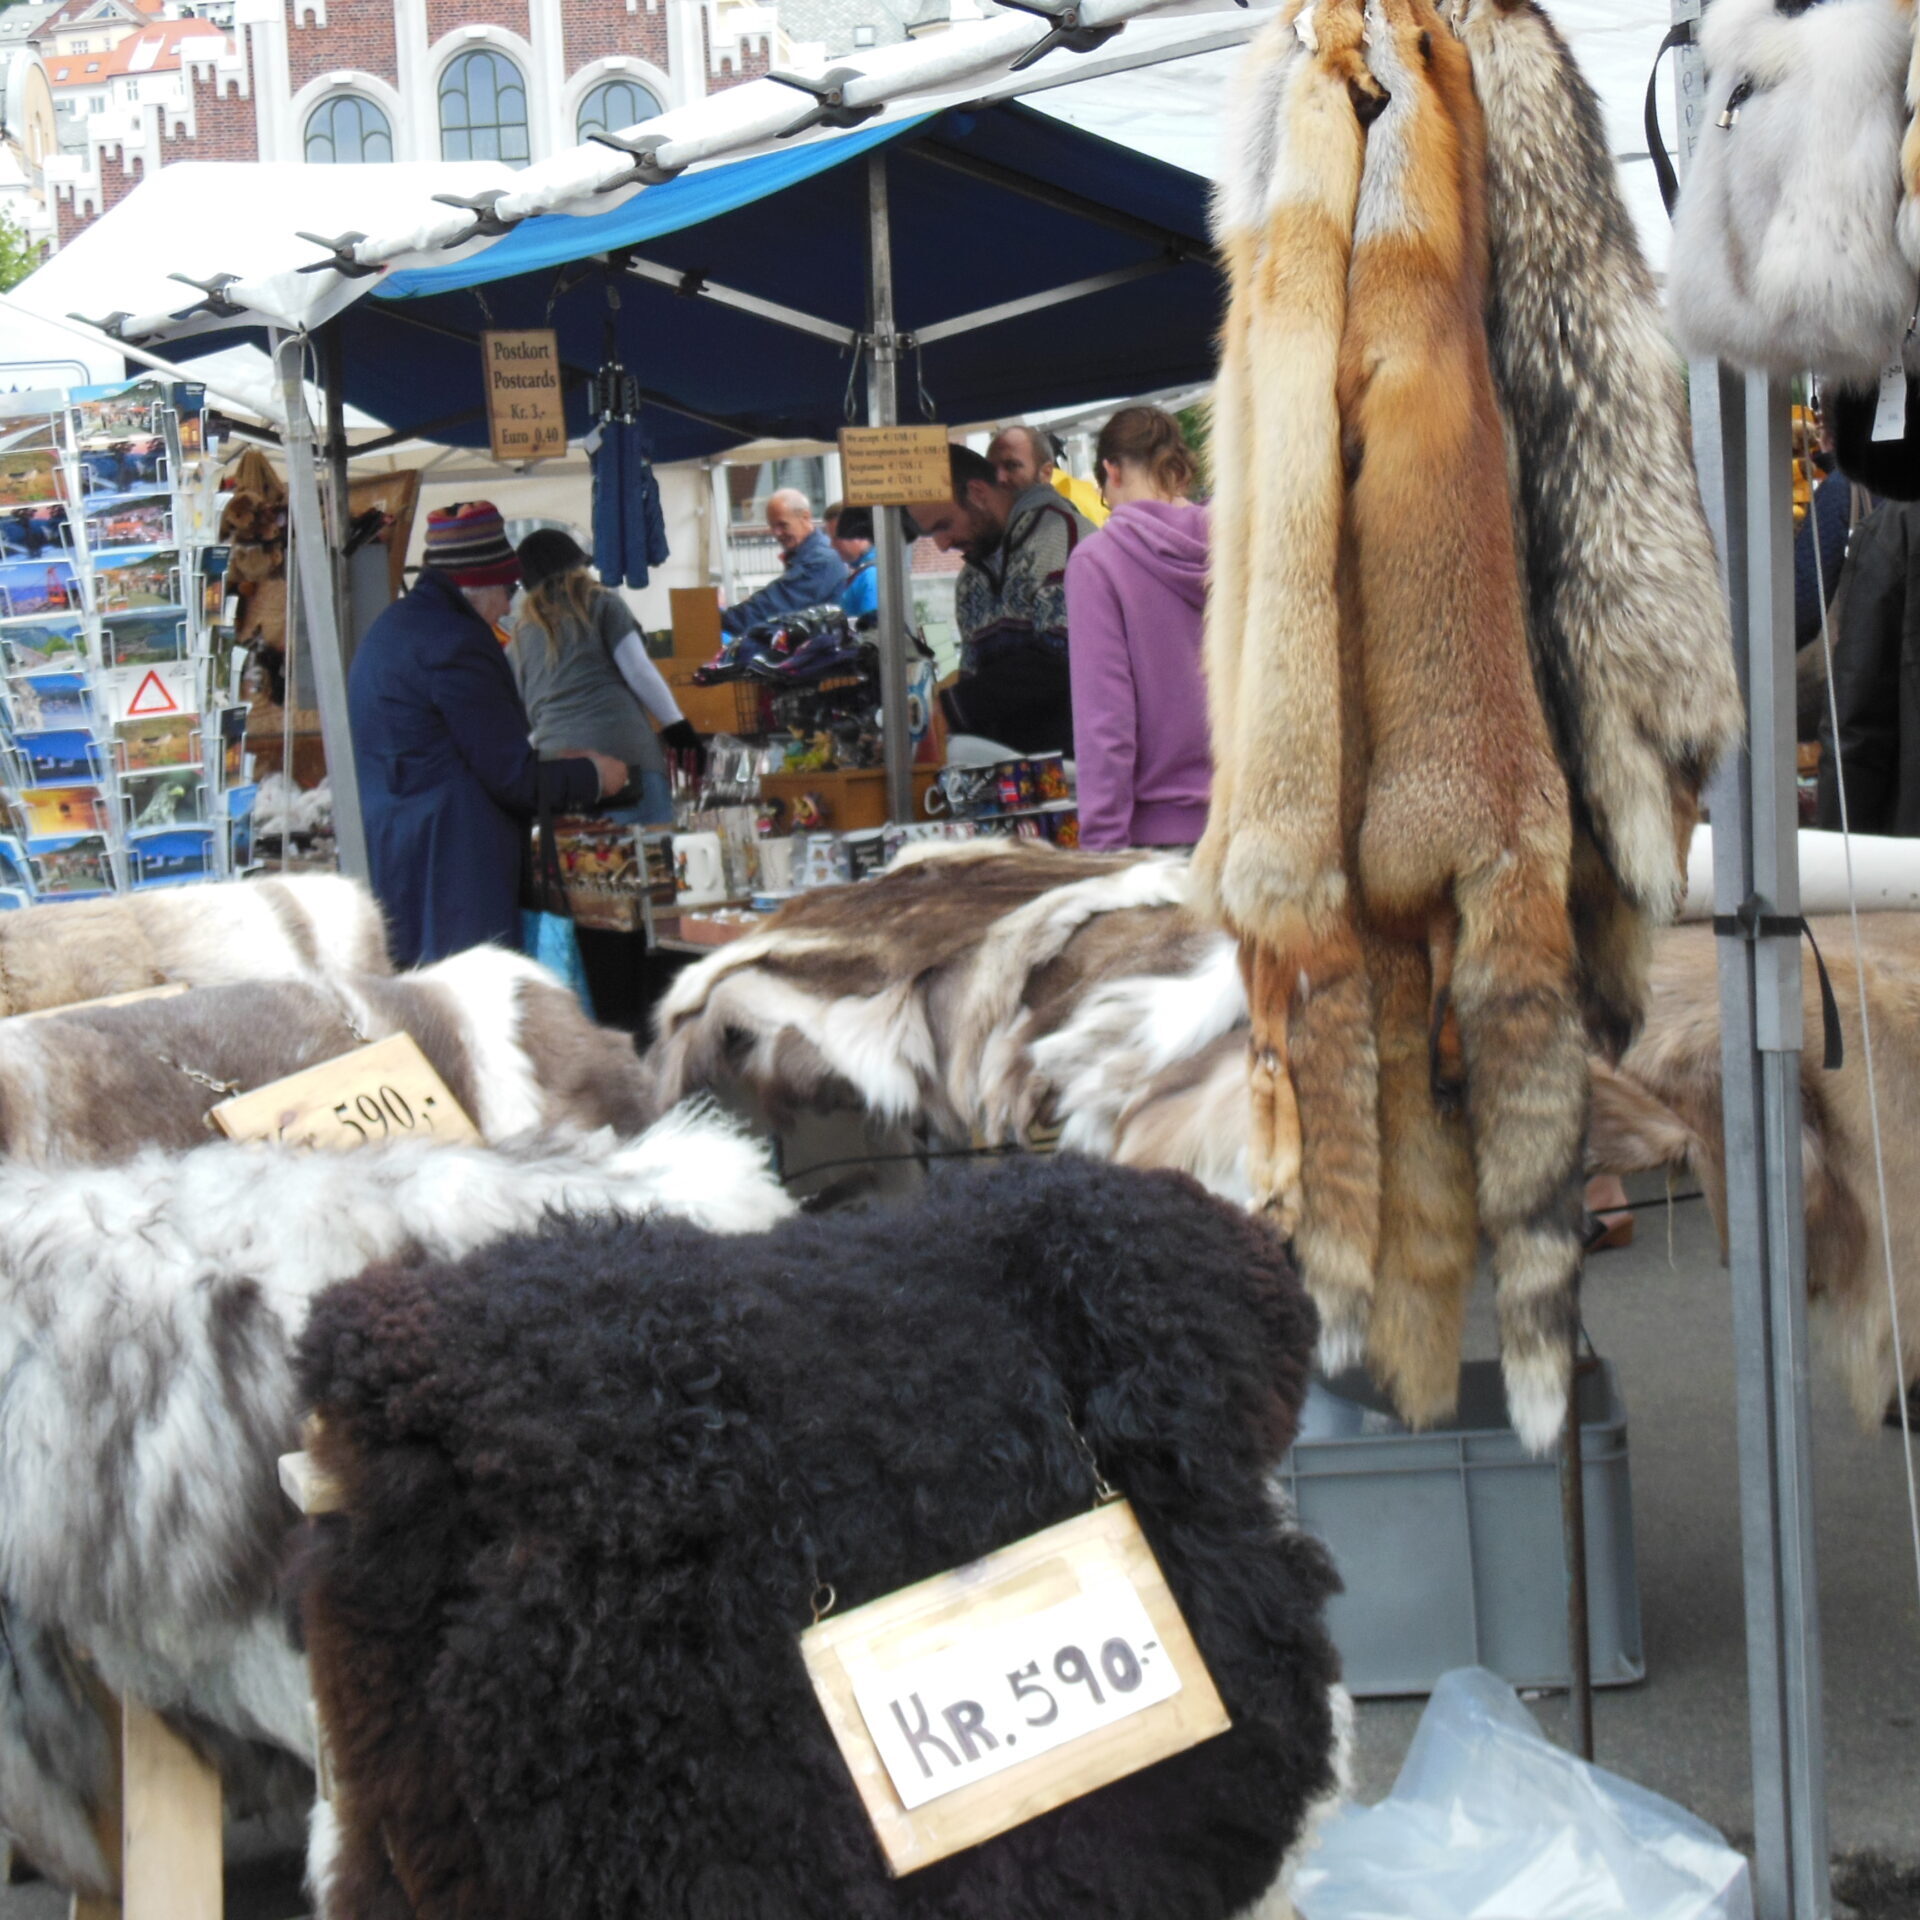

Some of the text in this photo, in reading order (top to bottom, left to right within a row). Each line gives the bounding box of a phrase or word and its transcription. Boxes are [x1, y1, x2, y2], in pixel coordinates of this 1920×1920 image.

[494, 341, 550, 360] Postkort
[494, 369, 557, 389] Postcards
[511, 403, 529, 420] Kr.
[502, 428, 529, 445] Euro
